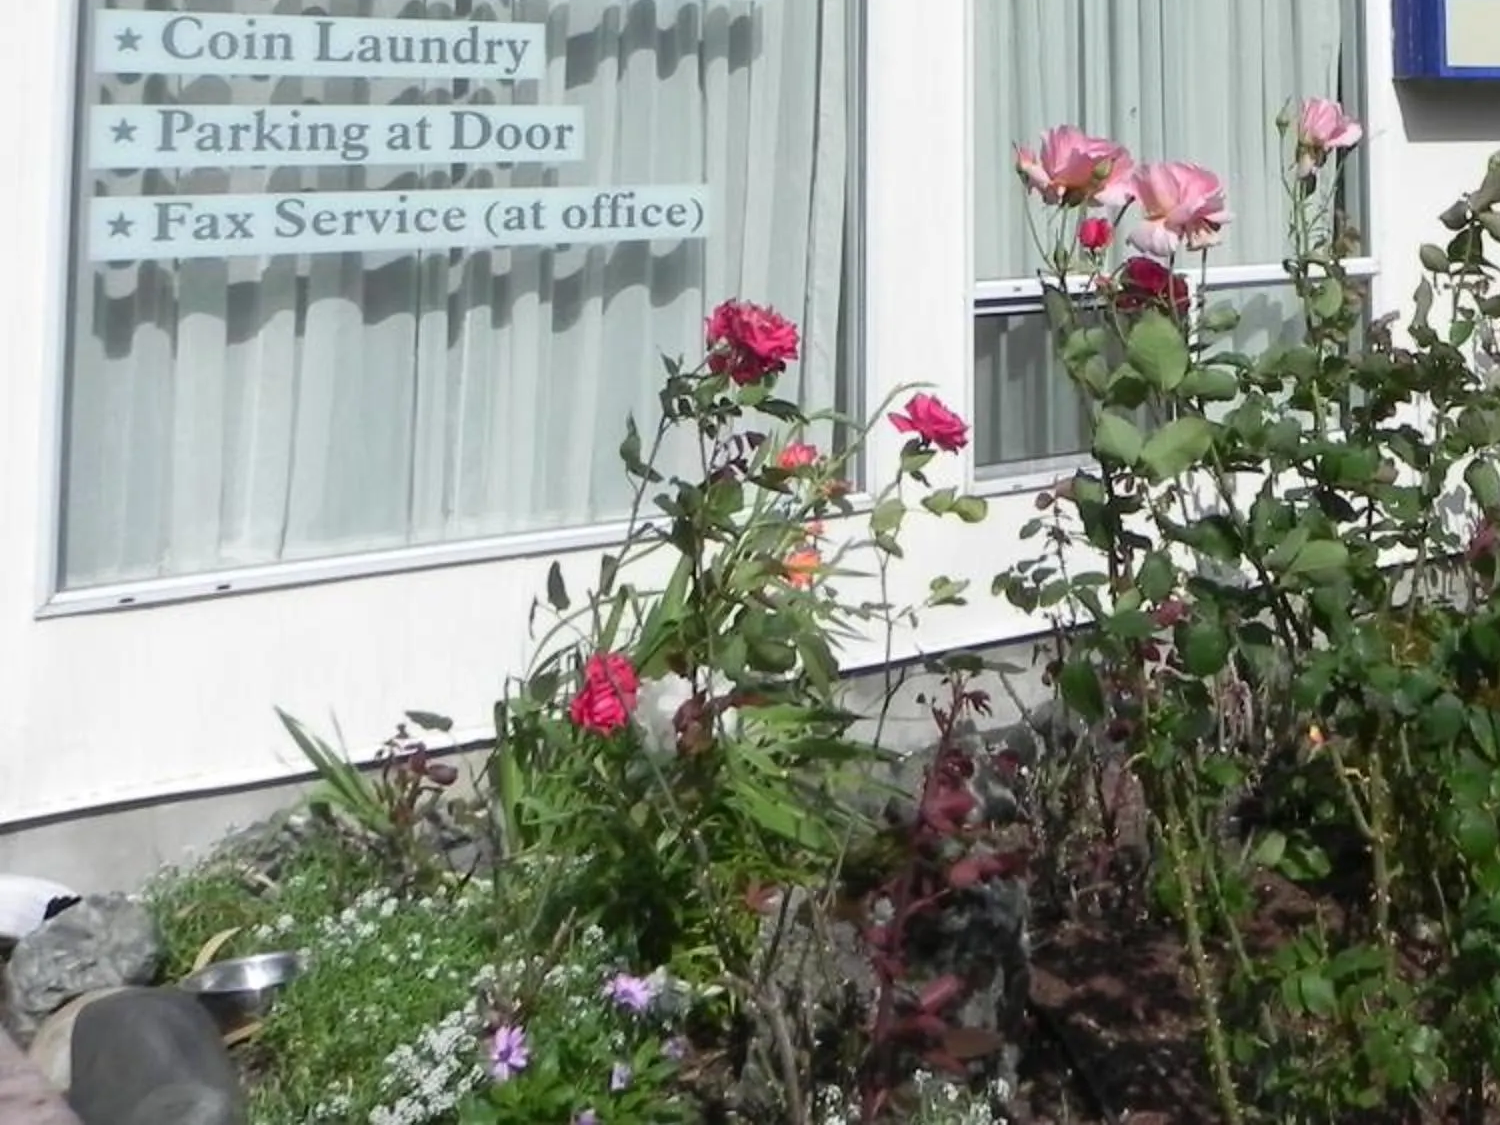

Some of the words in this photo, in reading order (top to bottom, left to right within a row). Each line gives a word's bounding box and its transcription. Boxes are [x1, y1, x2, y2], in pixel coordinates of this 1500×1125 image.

[161, 16, 294, 61] Coin
[314, 21, 530, 74] Laundry
[156, 109, 369, 160] Parking
[387, 114, 432, 151] at
[450, 110, 574, 151] Door
[152, 201, 255, 242] Fax
[274, 197, 467, 238] Service
[484, 197, 544, 237] (at
[562, 191, 704, 234] office)
